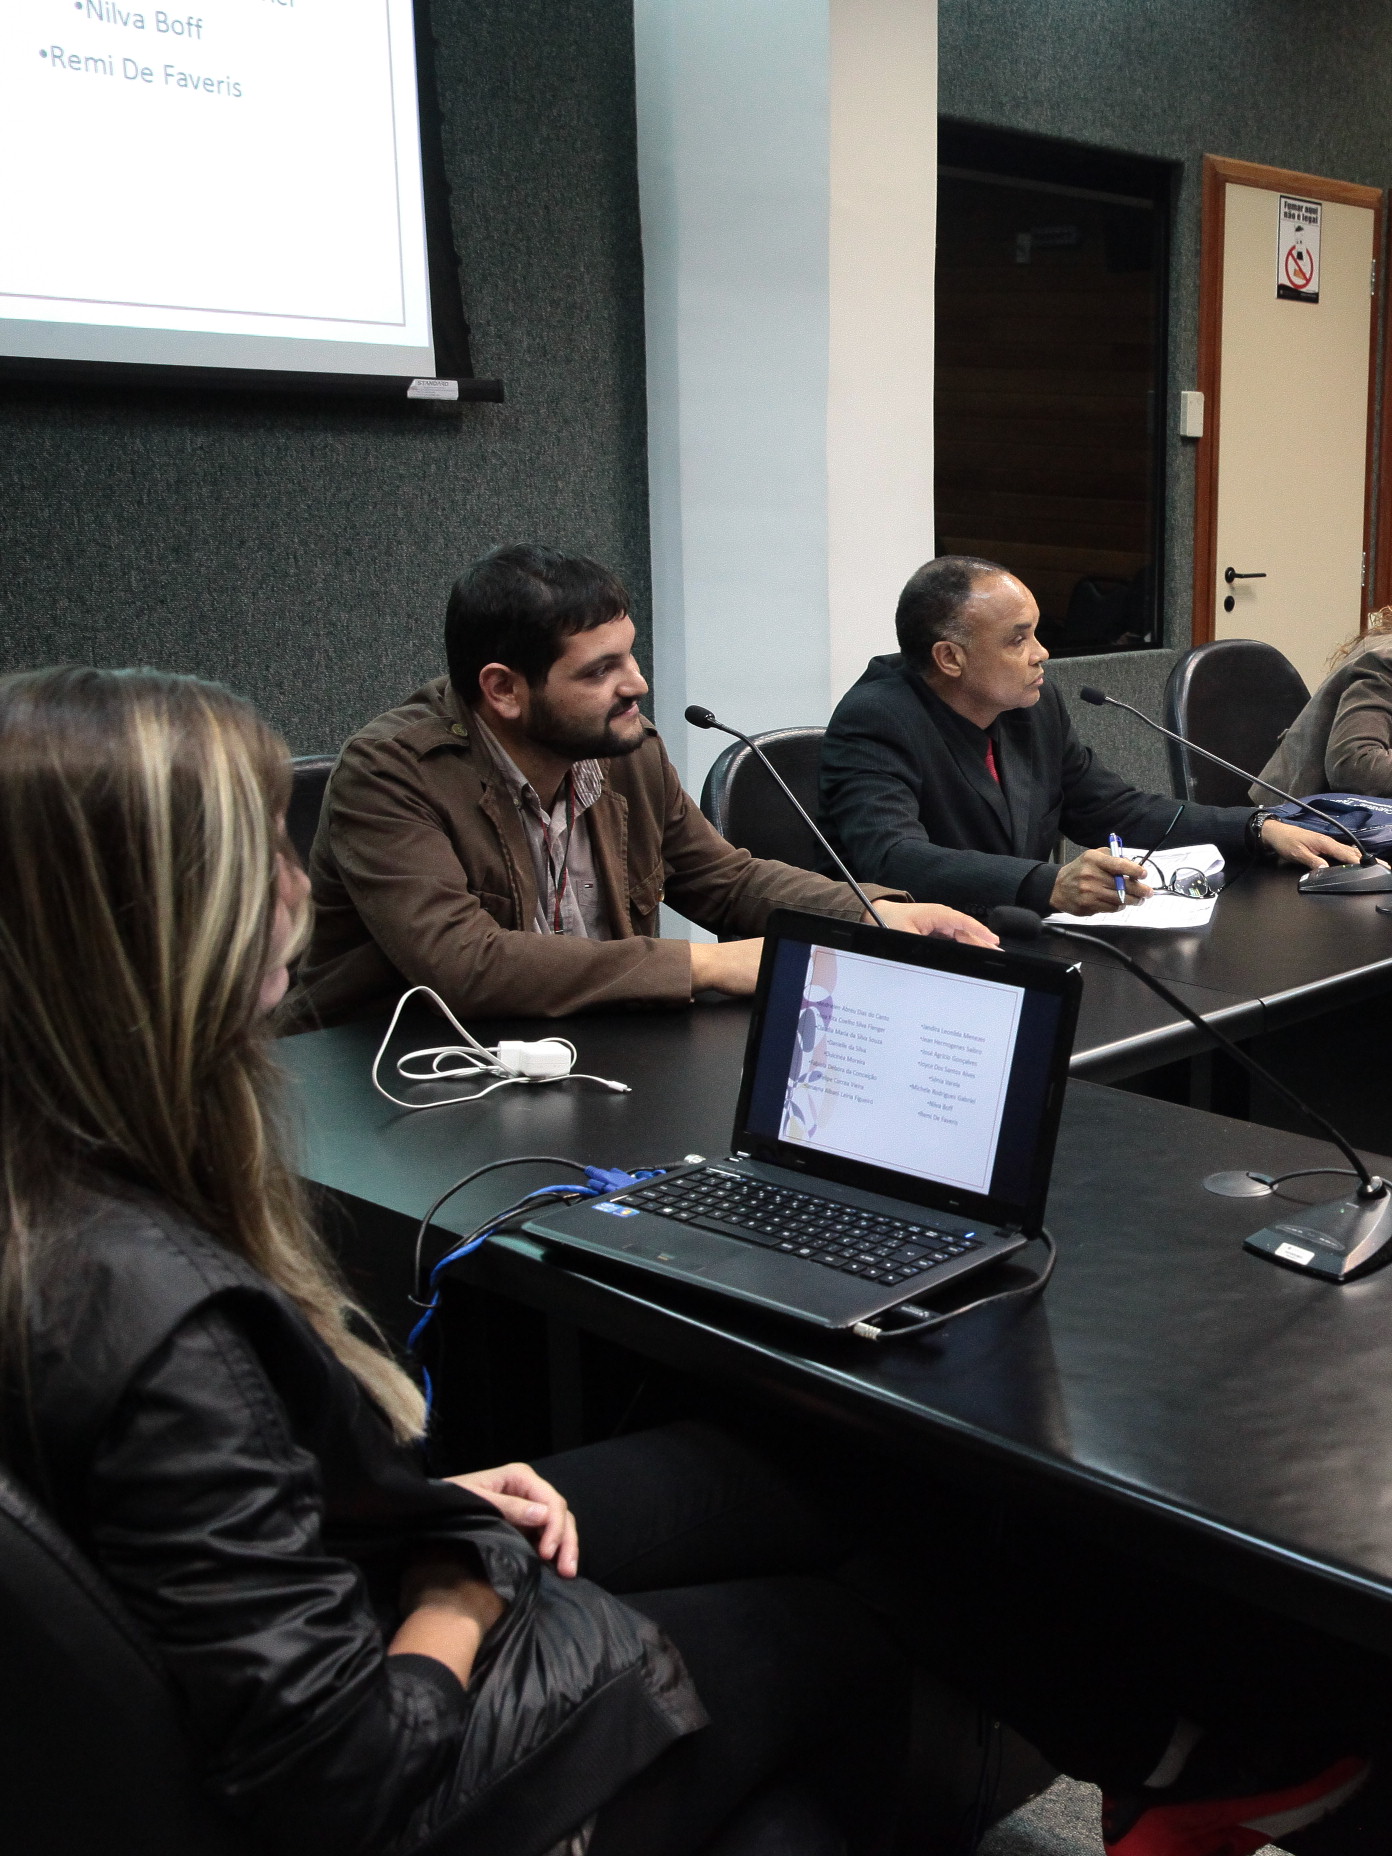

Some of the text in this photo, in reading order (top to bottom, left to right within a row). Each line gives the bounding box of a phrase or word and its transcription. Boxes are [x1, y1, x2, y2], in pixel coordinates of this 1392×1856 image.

[85, 0, 203, 39] Nilva Boff
[50, 45, 242, 98] Remi De Faveris
[1284, 201, 1318, 215] Fumar aqui
[1284, 211, 1296, 219] não
[1302, 213, 1318, 224] legal
[857, 1008, 867, 1016] Dias
[856, 1021, 867, 1029] Silva
[835, 1029, 849, 1037] Maria
[857, 1033, 868, 1041] Silva
[856, 1045, 867, 1053] Silva
